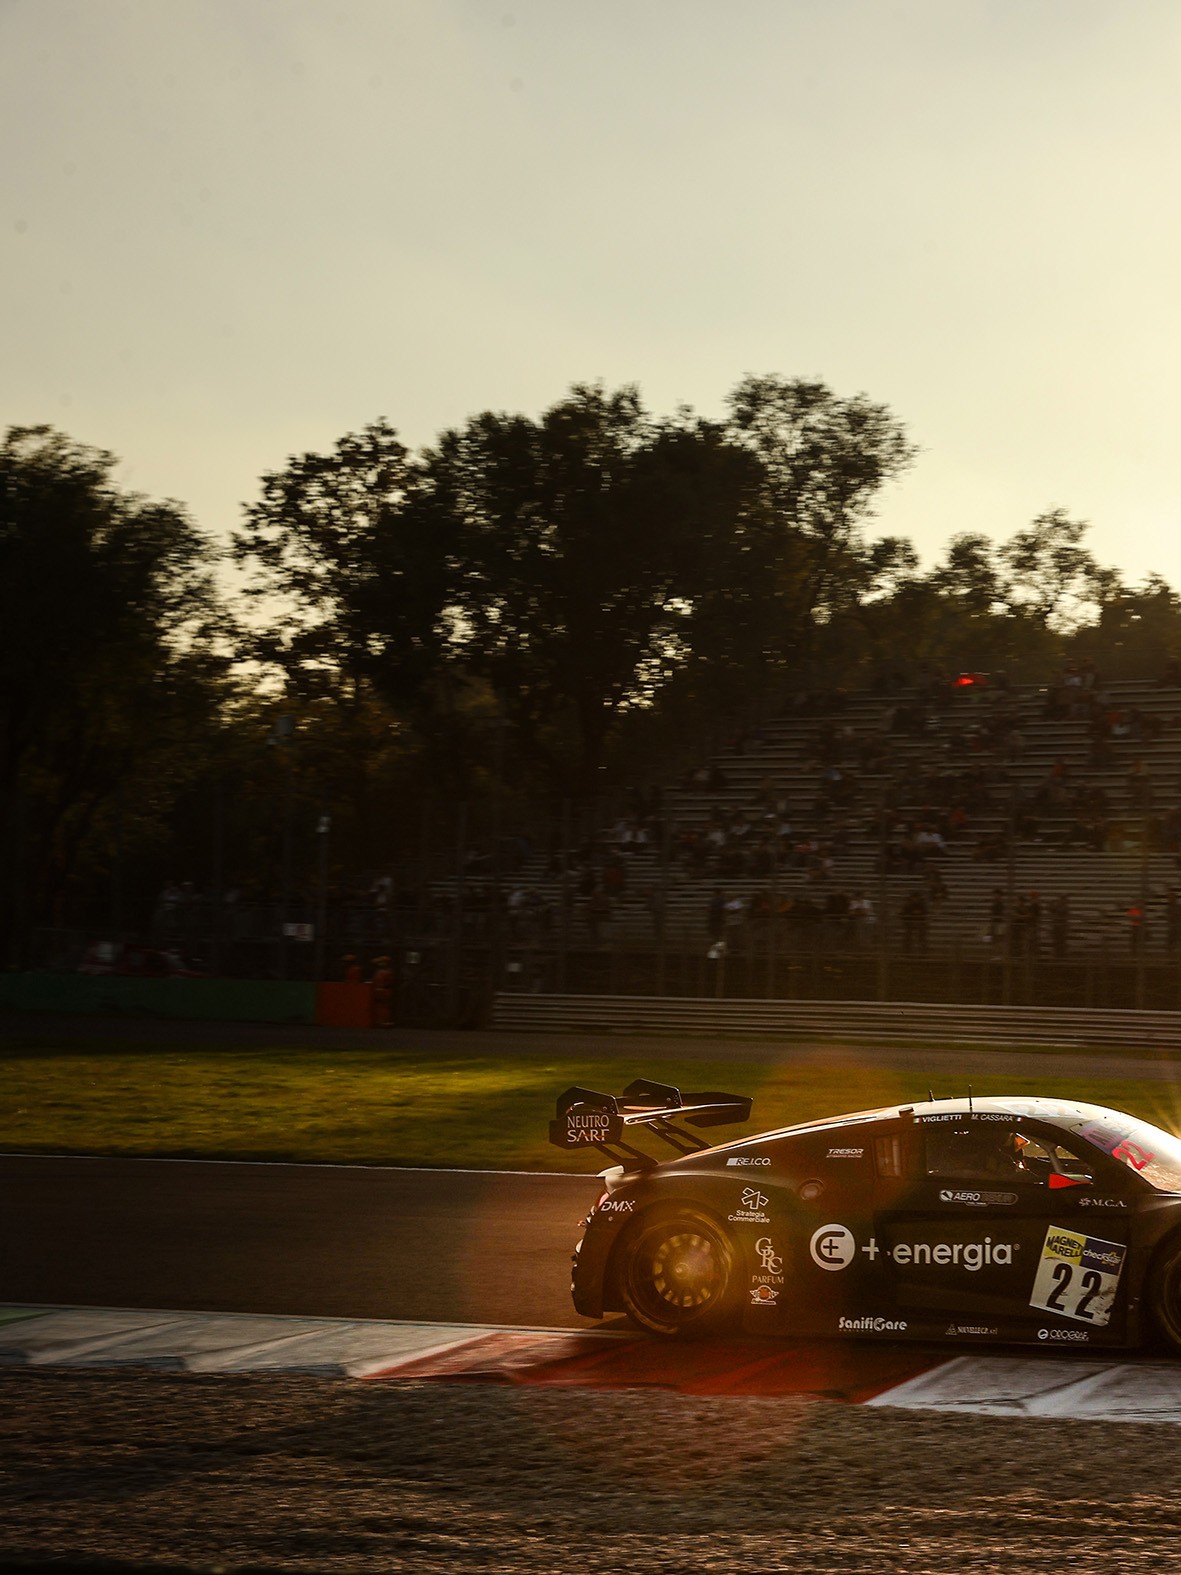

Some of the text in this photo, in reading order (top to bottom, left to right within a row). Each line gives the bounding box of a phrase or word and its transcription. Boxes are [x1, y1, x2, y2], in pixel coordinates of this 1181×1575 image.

[567, 1114, 610, 1128] NEUTRO
[922, 1114, 962, 1123] VIGLIETTI
[1112, 1140, 1155, 1171] 22
[953, 1192, 981, 1201] AERO
[600, 1200, 635, 1212] DMX
[736, 1209, 765, 1218] Strategia
[893, 1236, 1012, 1272] energia
[752, 1275, 784, 1284] PARFUM
[1046, 1263, 1102, 1320] 22
